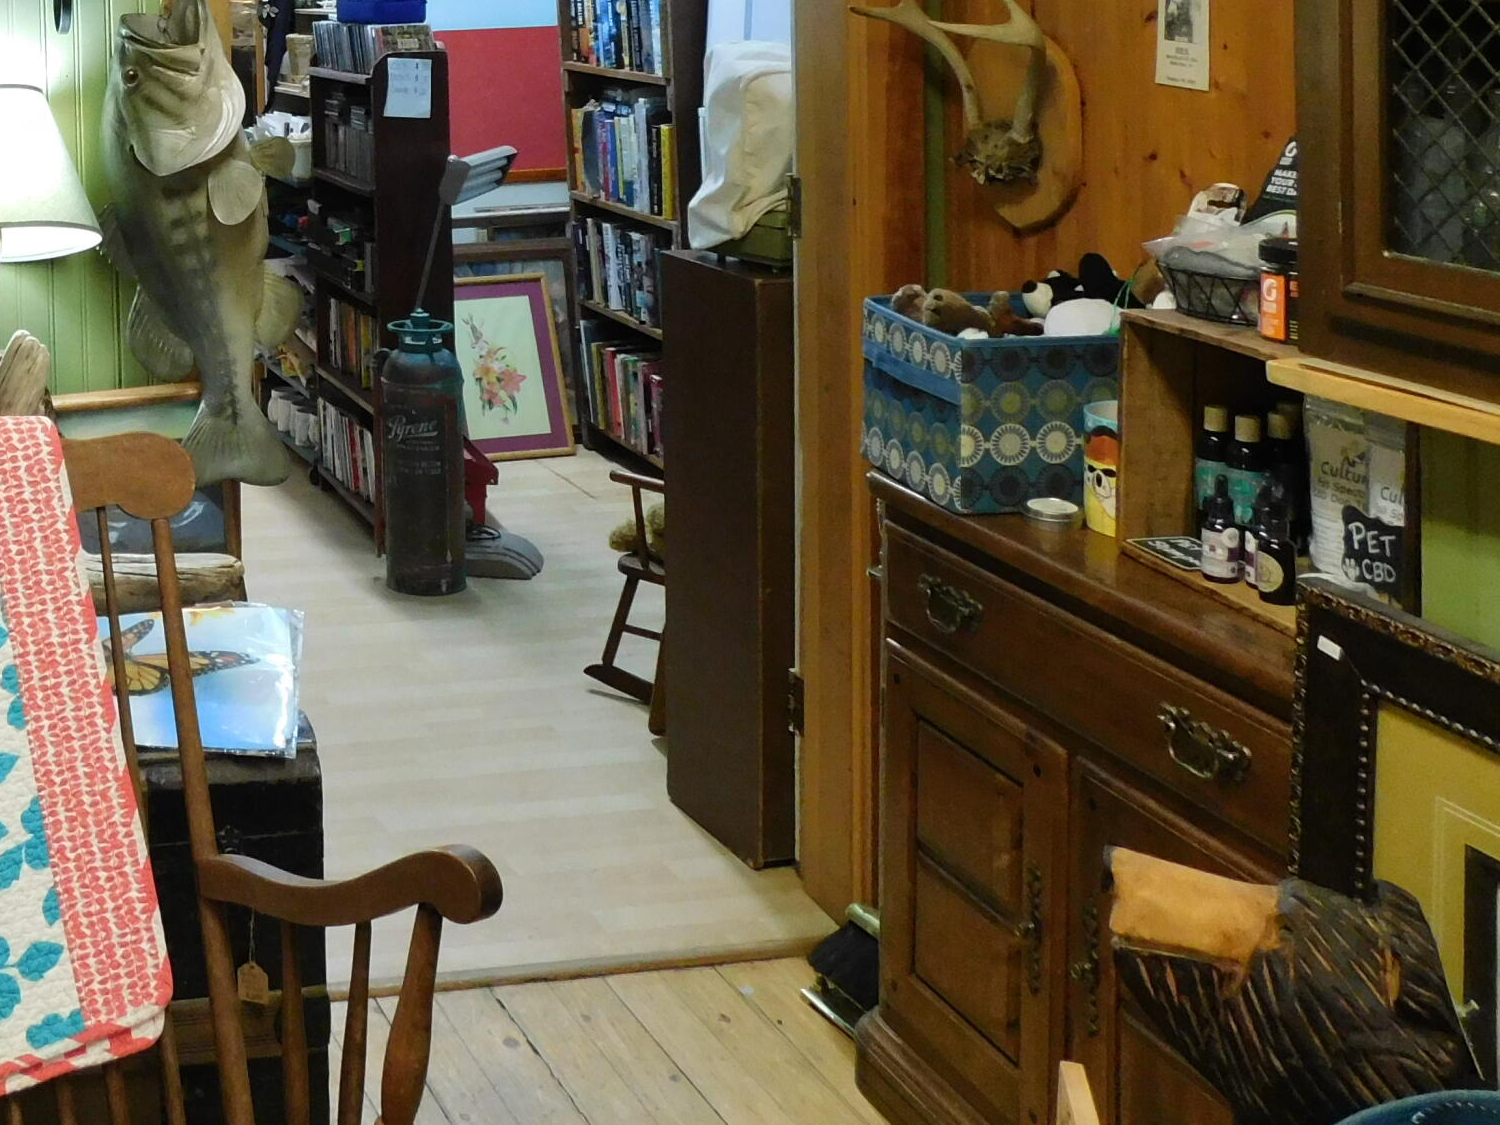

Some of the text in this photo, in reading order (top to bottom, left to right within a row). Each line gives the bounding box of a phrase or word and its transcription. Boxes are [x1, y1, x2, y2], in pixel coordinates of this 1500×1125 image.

[1265, 184, 1287, 194] BEST
[1270, 176, 1295, 187] YOUR
[387, 415, 438, 442] Pyrene
[1348, 521, 1396, 558] PET
[1361, 559, 1397, 583] CBD
